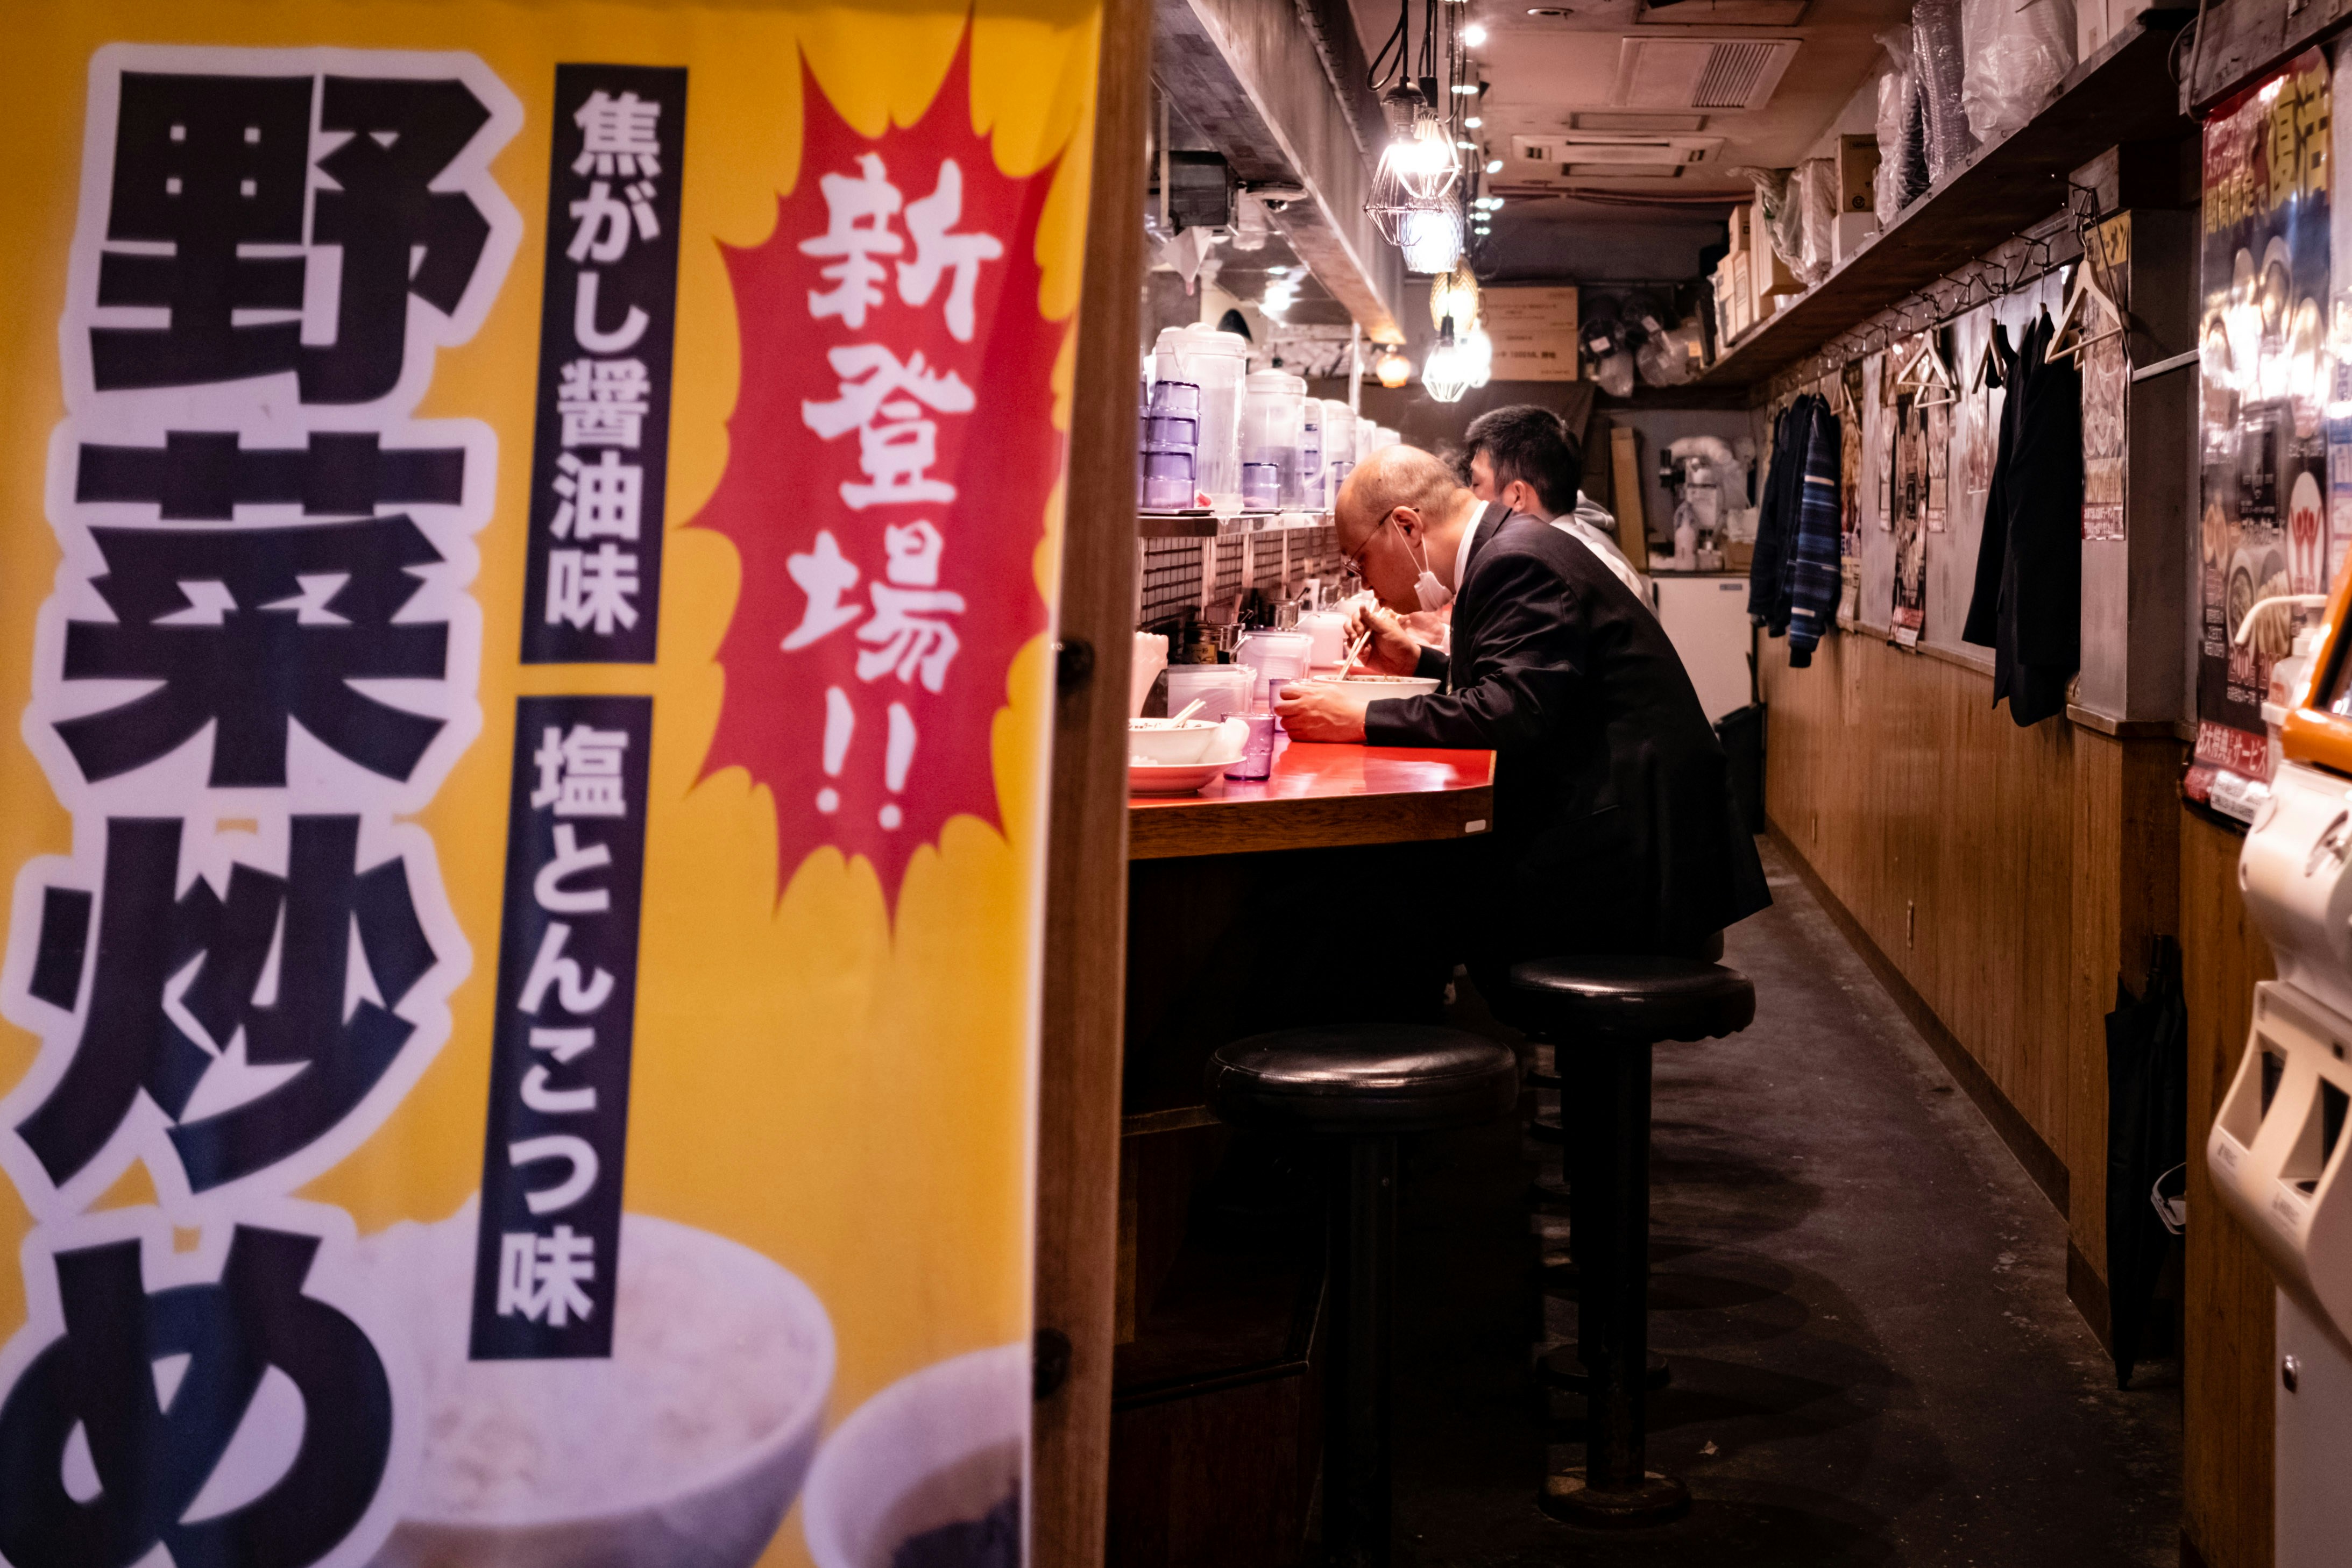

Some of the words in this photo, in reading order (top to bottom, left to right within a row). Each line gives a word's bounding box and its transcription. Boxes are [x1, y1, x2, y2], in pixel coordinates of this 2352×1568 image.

[544, 90, 663, 635] 焦がし醤油味
[782, 153, 1003, 831] 新登場!!
[0, 70, 492, 1568] 野菜炒め
[498, 725, 632, 1328] 塩とんこつ味
